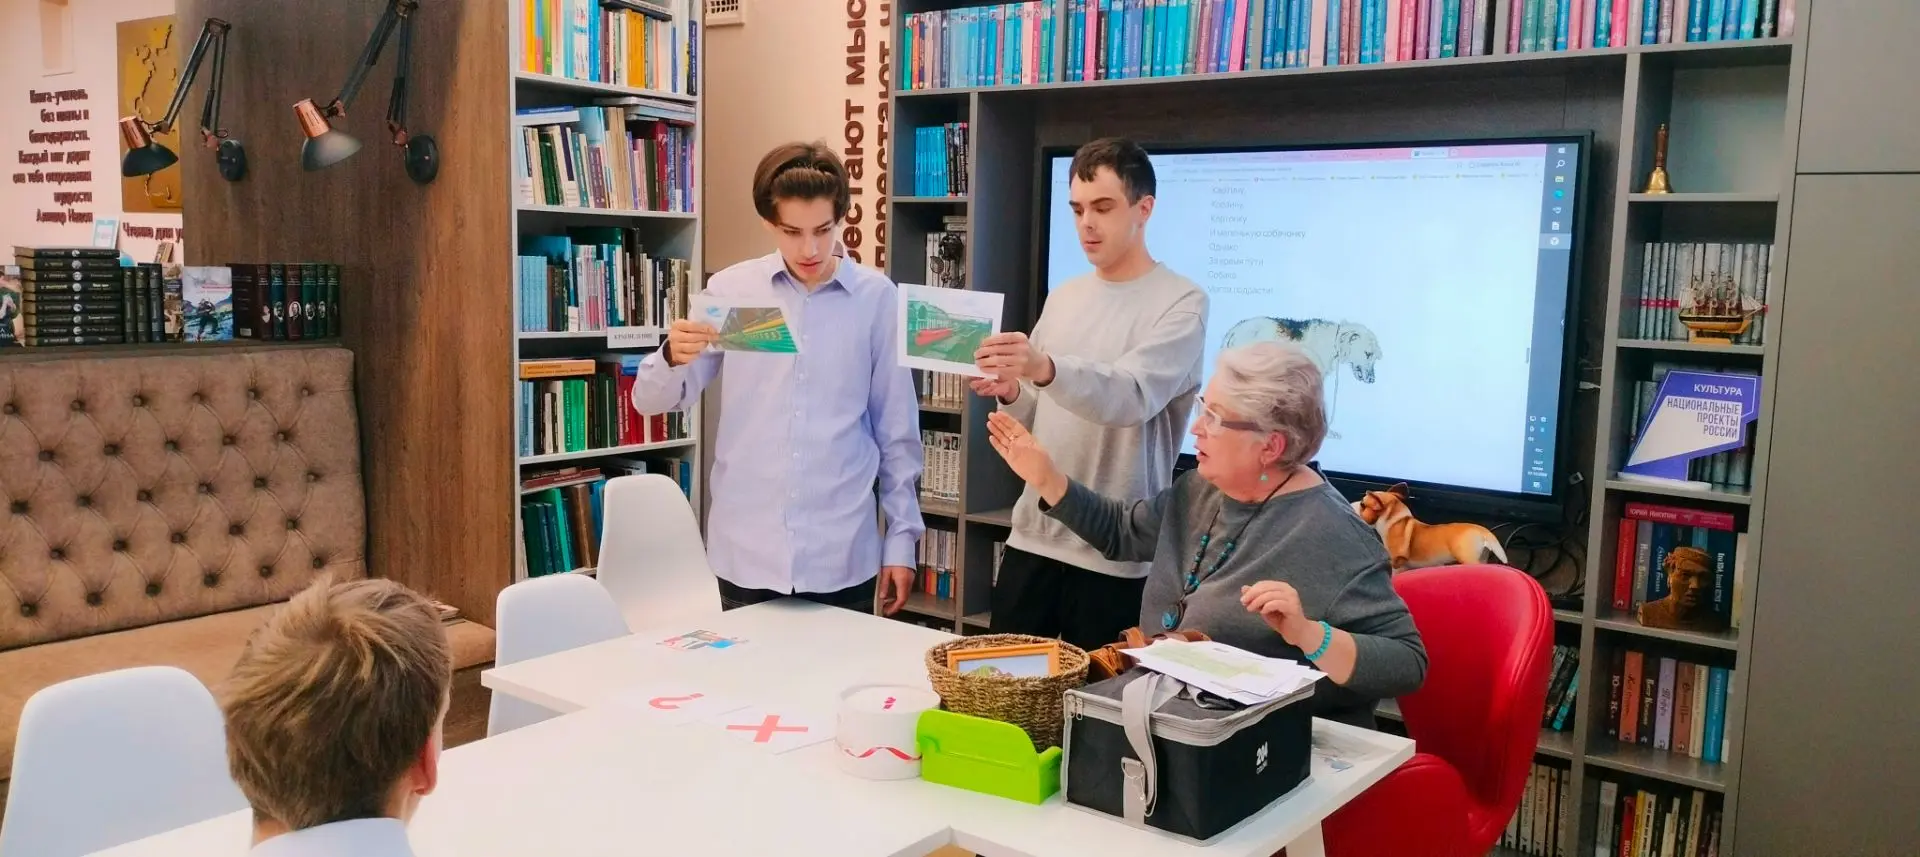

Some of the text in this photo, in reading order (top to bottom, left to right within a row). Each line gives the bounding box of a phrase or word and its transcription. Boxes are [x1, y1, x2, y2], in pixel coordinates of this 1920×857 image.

[41, 108, 55, 123] без
[18, 150, 48, 165] Каждый
[27, 169, 44, 183] тебе
[122, 222, 154, 238] Чтение
[155, 228, 174, 240] для
[1693, 384, 1743, 397] КУЛЬТУРА
[1667, 398, 1740, 415] НАЦИОНАЛЬНЫЕ
[1696, 412, 1739, 427] ПРОЕКТЫ
[1703, 424, 1738, 439] РОССИИ
